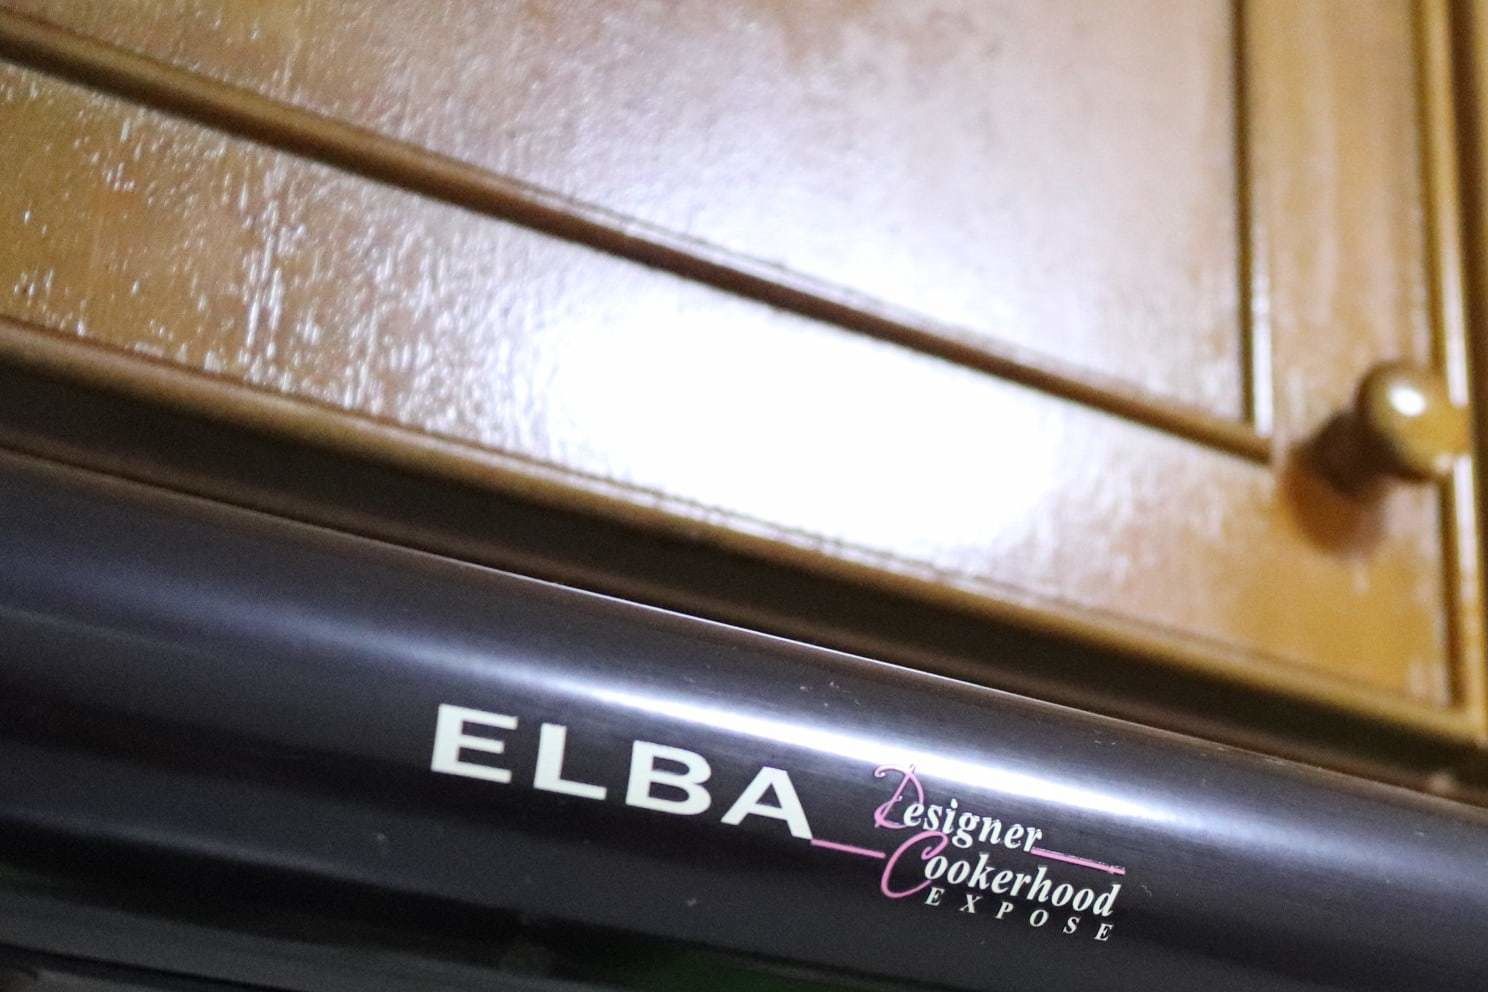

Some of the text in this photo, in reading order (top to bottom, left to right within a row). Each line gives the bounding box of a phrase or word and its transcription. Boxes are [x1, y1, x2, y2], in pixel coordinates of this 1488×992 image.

[430, 703, 814, 841] ELBA
[874, 763, 1043, 852] Designer
[881, 831, 1121, 918] Cookerhood
[925, 886, 1113, 942] EXPOSE
